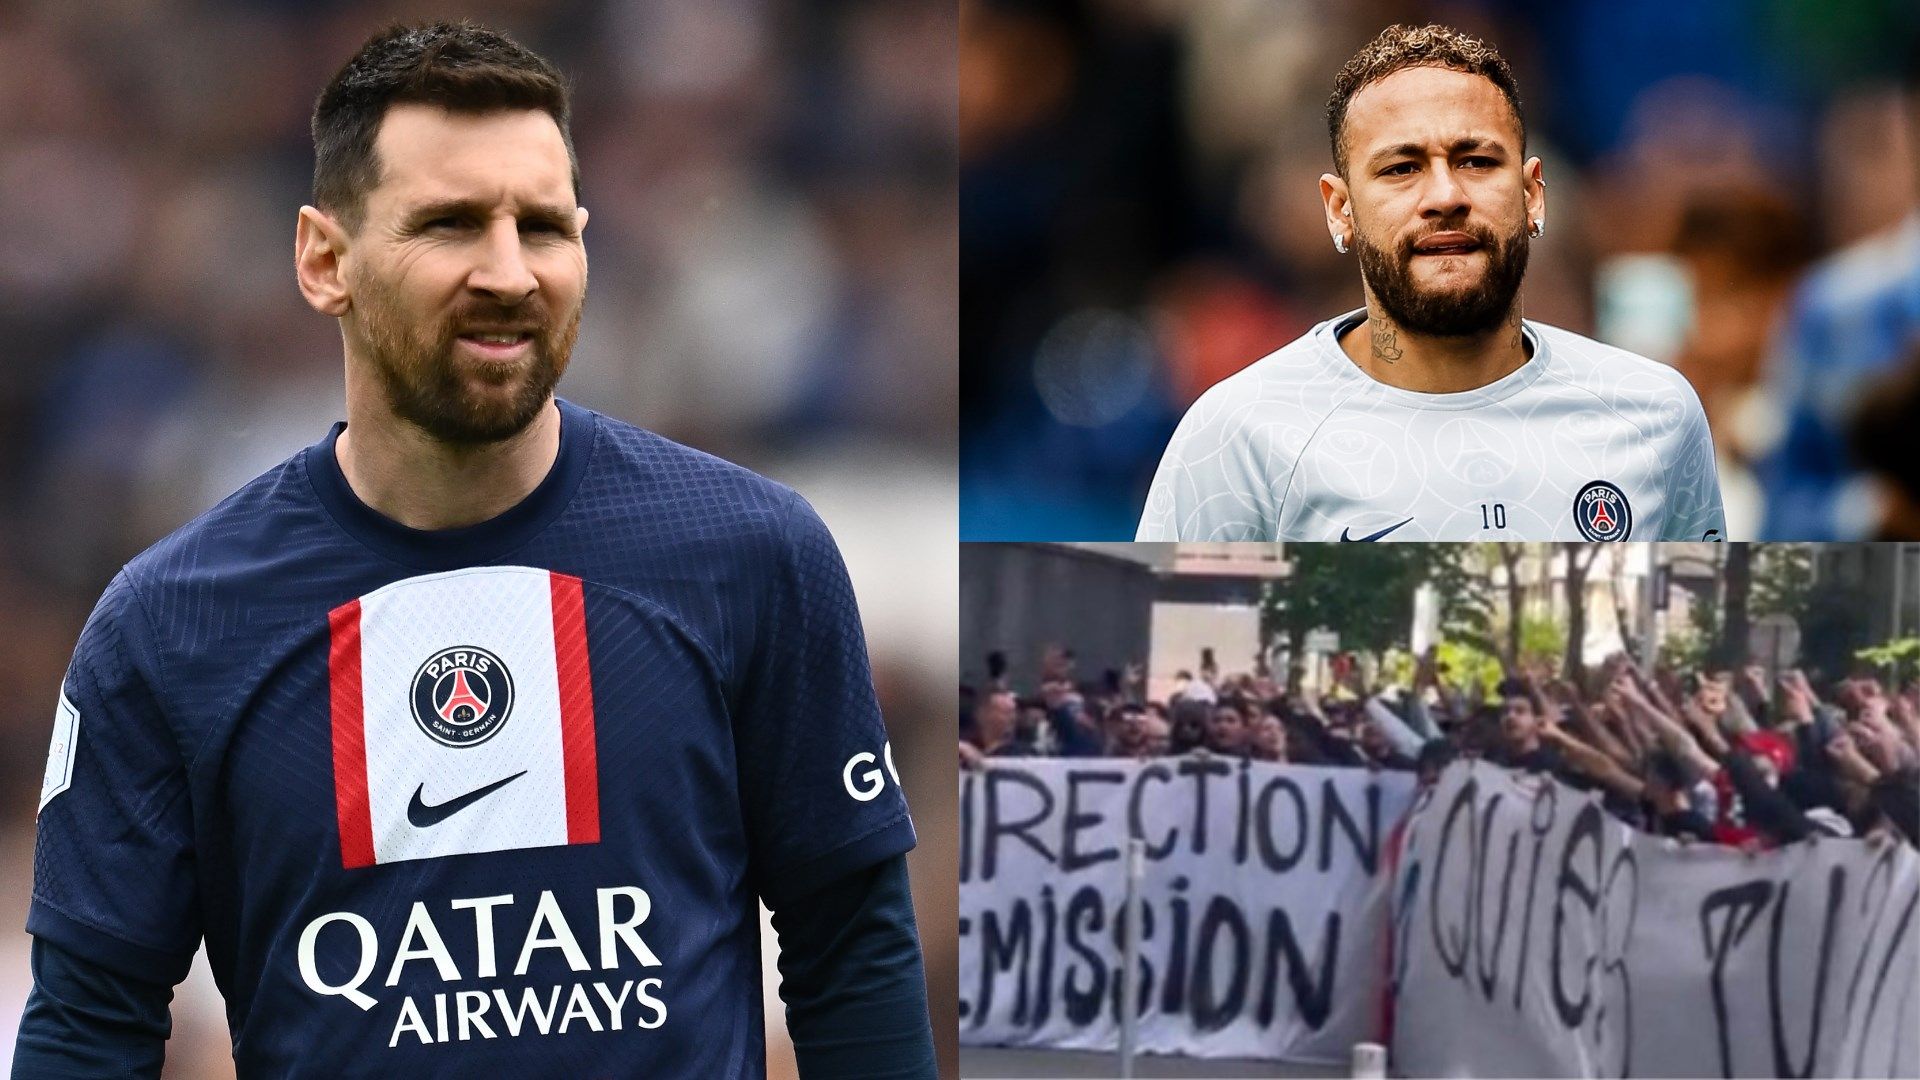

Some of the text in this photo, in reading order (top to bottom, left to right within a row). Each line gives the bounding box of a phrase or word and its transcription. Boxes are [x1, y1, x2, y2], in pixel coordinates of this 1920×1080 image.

[1584, 489, 1618, 504] PARIS
[1481, 503, 1506, 529] 10
[426, 652, 491, 679] PARIS
[297, 886, 663, 1012] QATAR
[388, 978, 668, 1048] AIRWAYS
